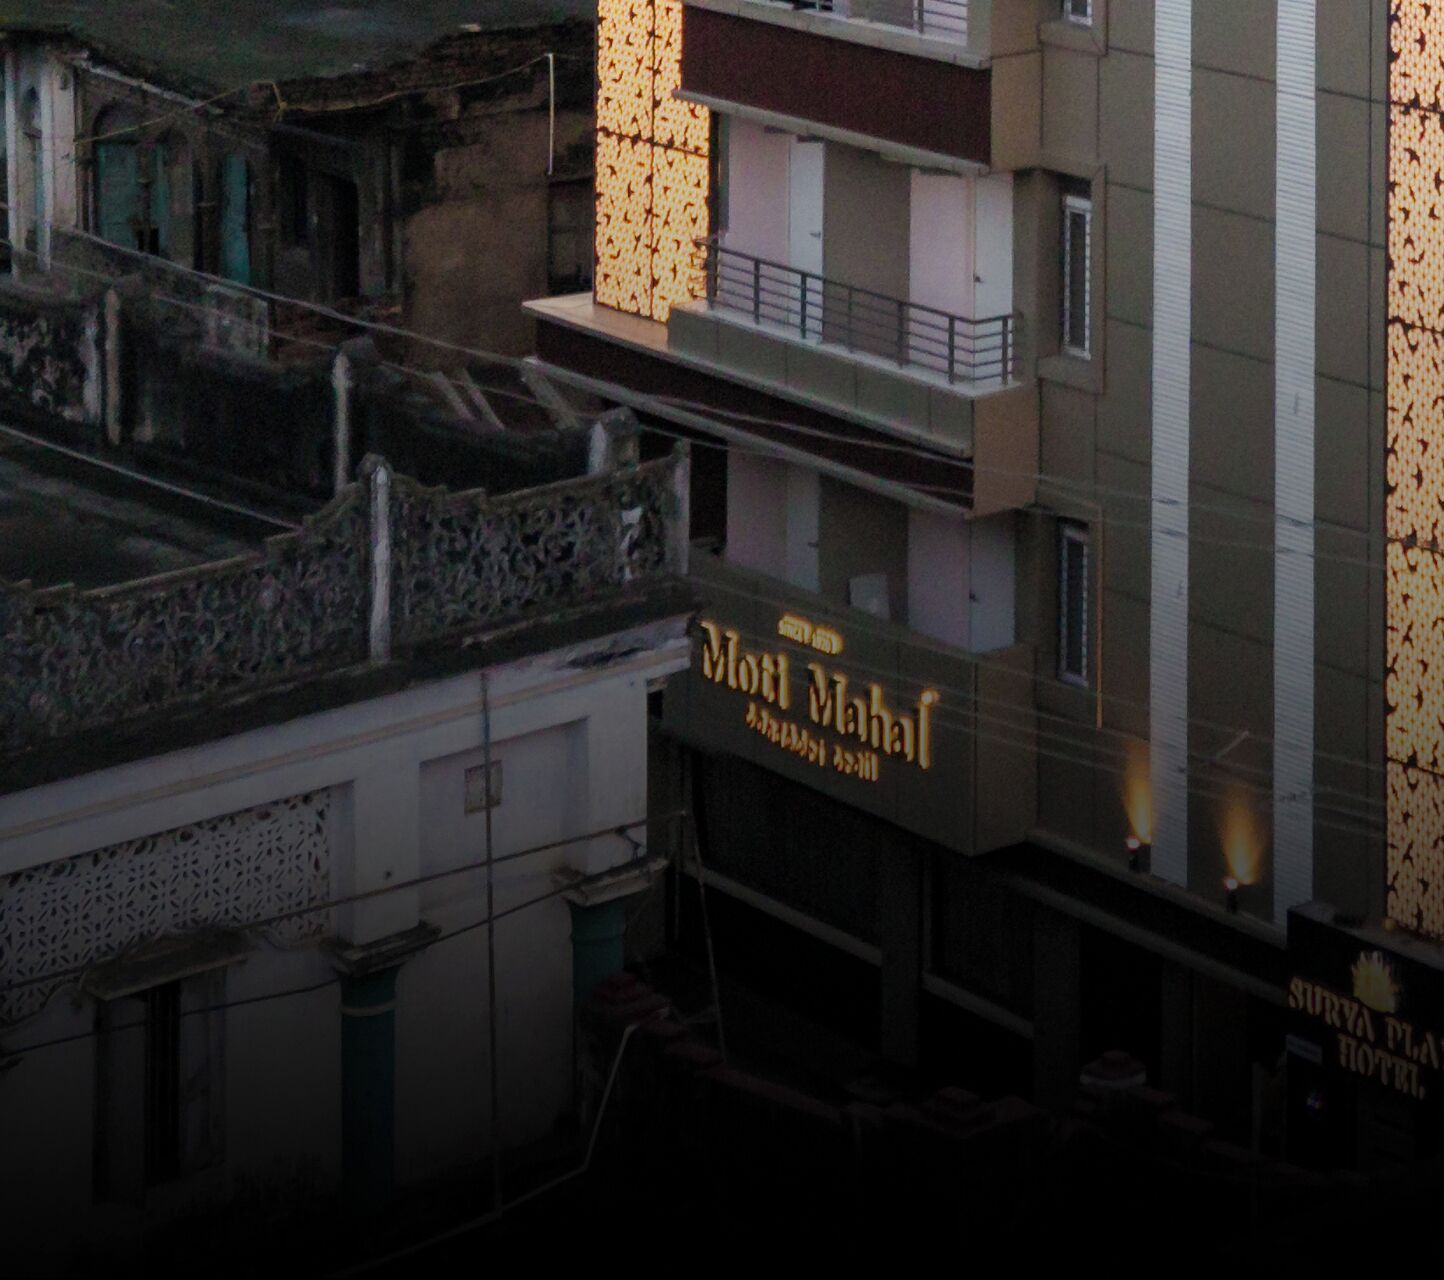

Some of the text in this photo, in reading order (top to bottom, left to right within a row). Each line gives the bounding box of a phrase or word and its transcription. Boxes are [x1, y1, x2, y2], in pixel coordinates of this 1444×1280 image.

[701, 620, 789, 710] Moti
[807, 662, 940, 770] Mahal
[1289, 977, 1375, 1044] SURYA
[1338, 1032, 1426, 1101] HOTEL
